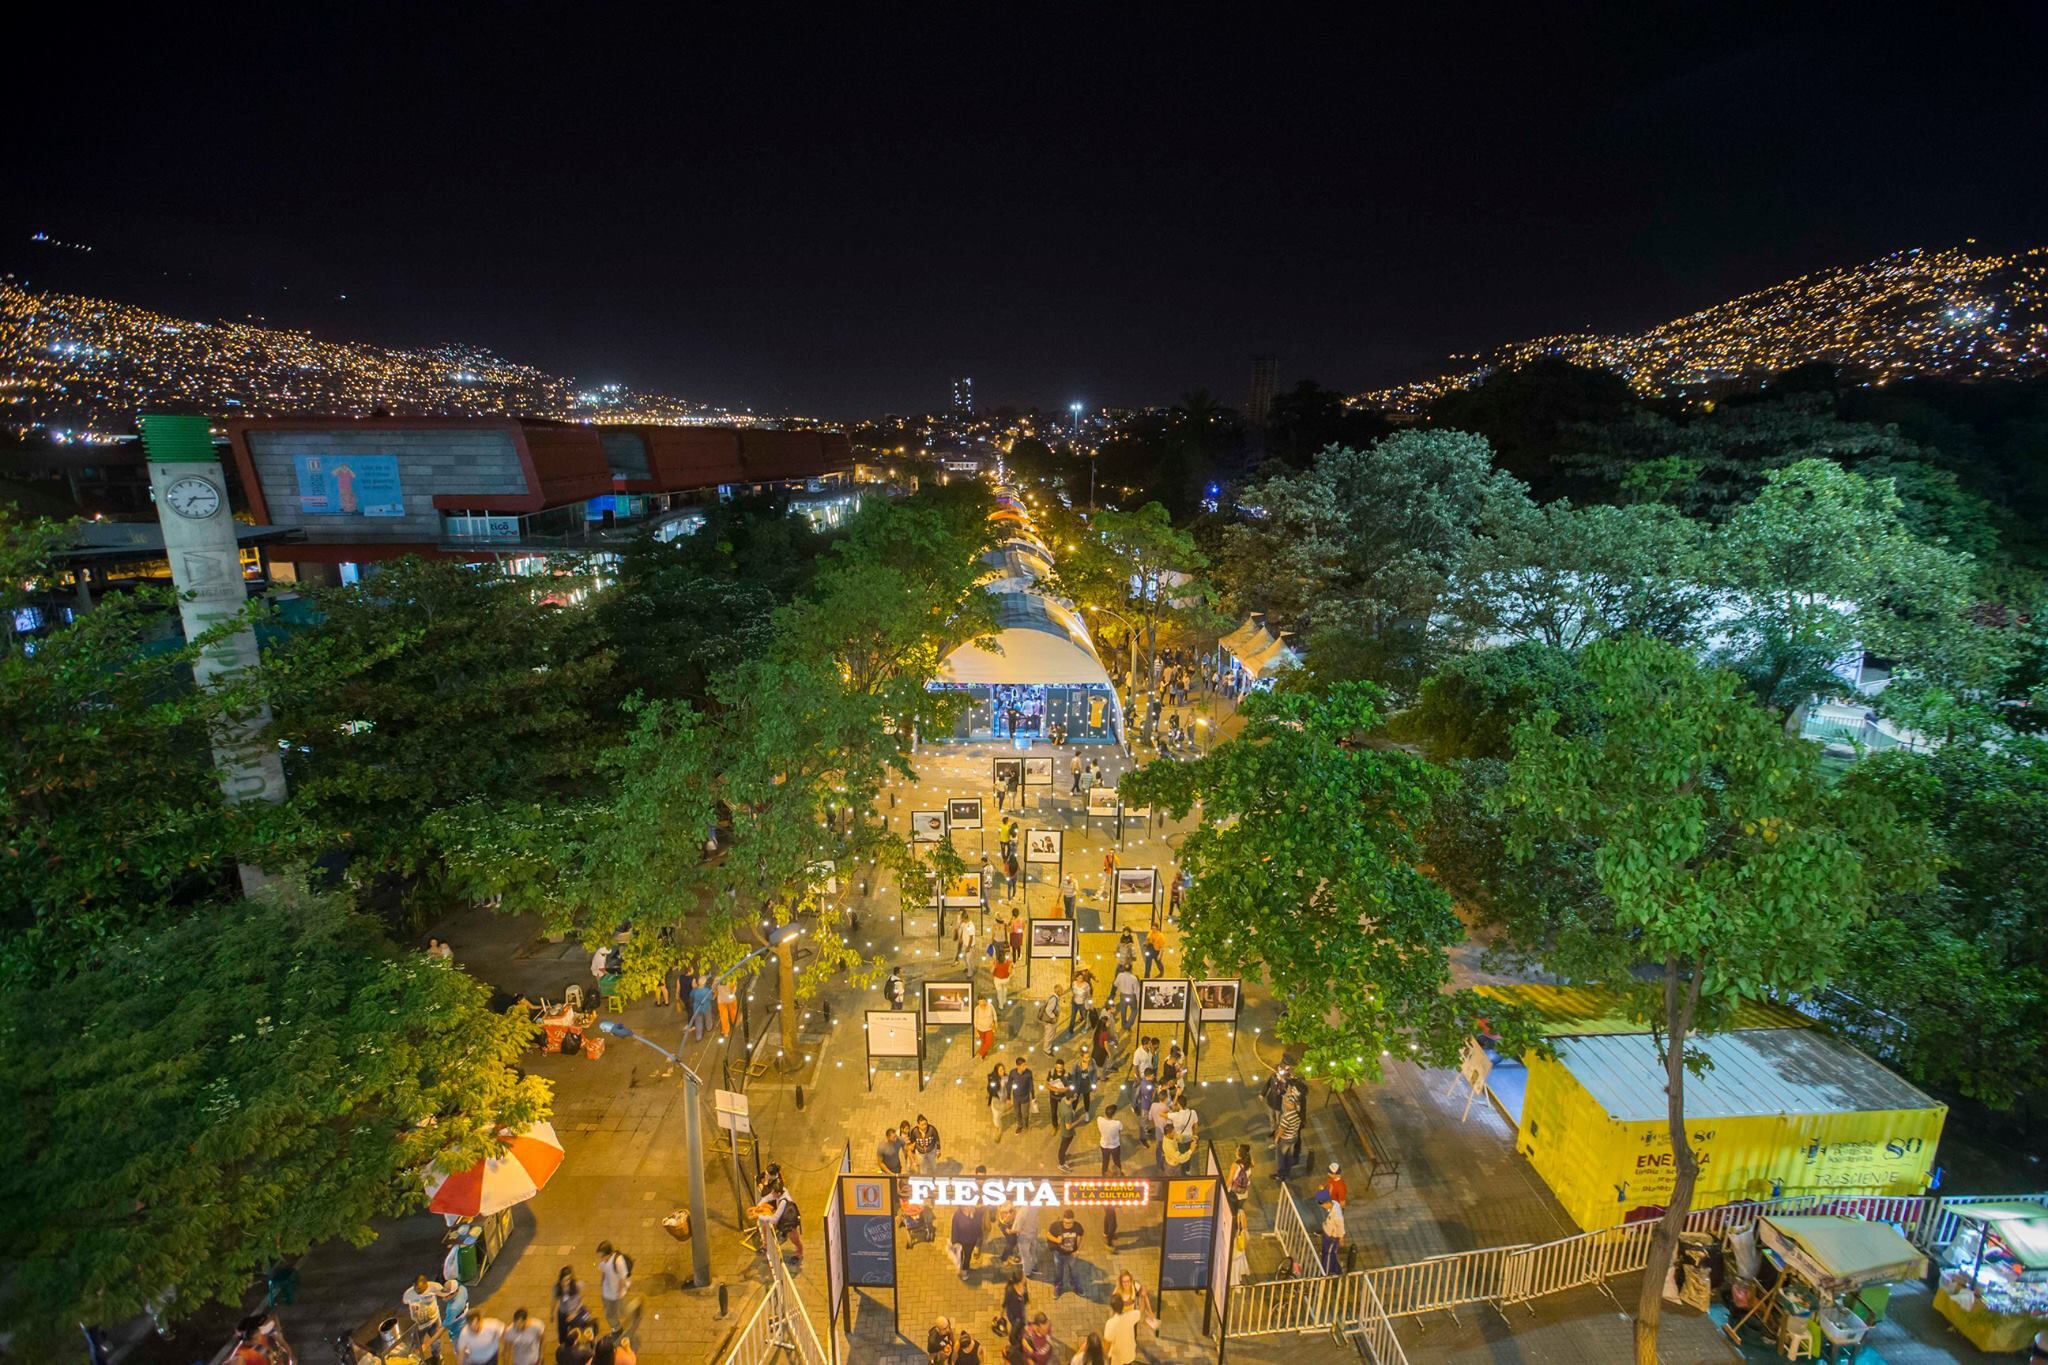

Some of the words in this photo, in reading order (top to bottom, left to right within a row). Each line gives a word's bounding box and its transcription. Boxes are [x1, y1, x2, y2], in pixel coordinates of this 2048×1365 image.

[1883, 1137, 1922, 1160] 80
[862, 1186, 879, 1203] 10
[908, 1177, 1060, 1207] FIESTA
